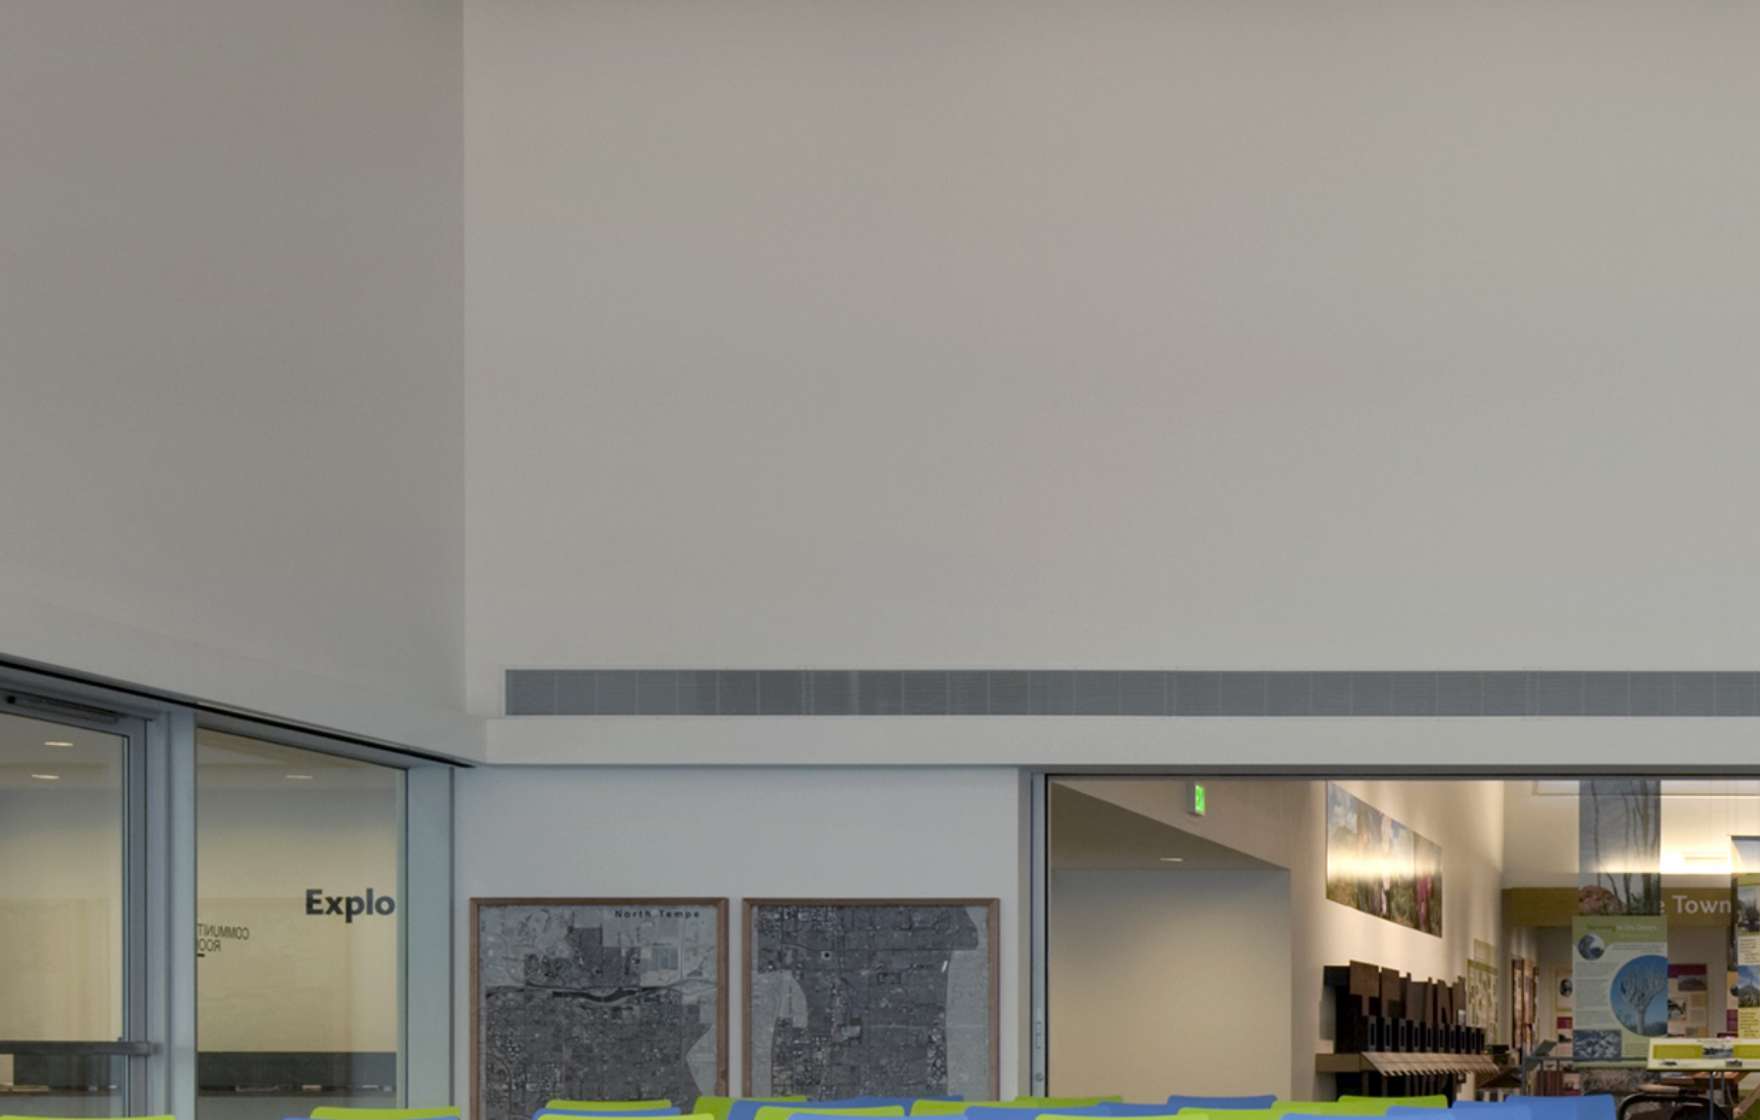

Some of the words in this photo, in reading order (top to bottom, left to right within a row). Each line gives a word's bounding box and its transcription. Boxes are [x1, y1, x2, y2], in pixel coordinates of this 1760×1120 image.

[305, 887, 396, 924] Explo
[1671, 895, 1732, 913] Town
[614, 909, 652, 918] North
[659, 909, 700, 919] Tempe
